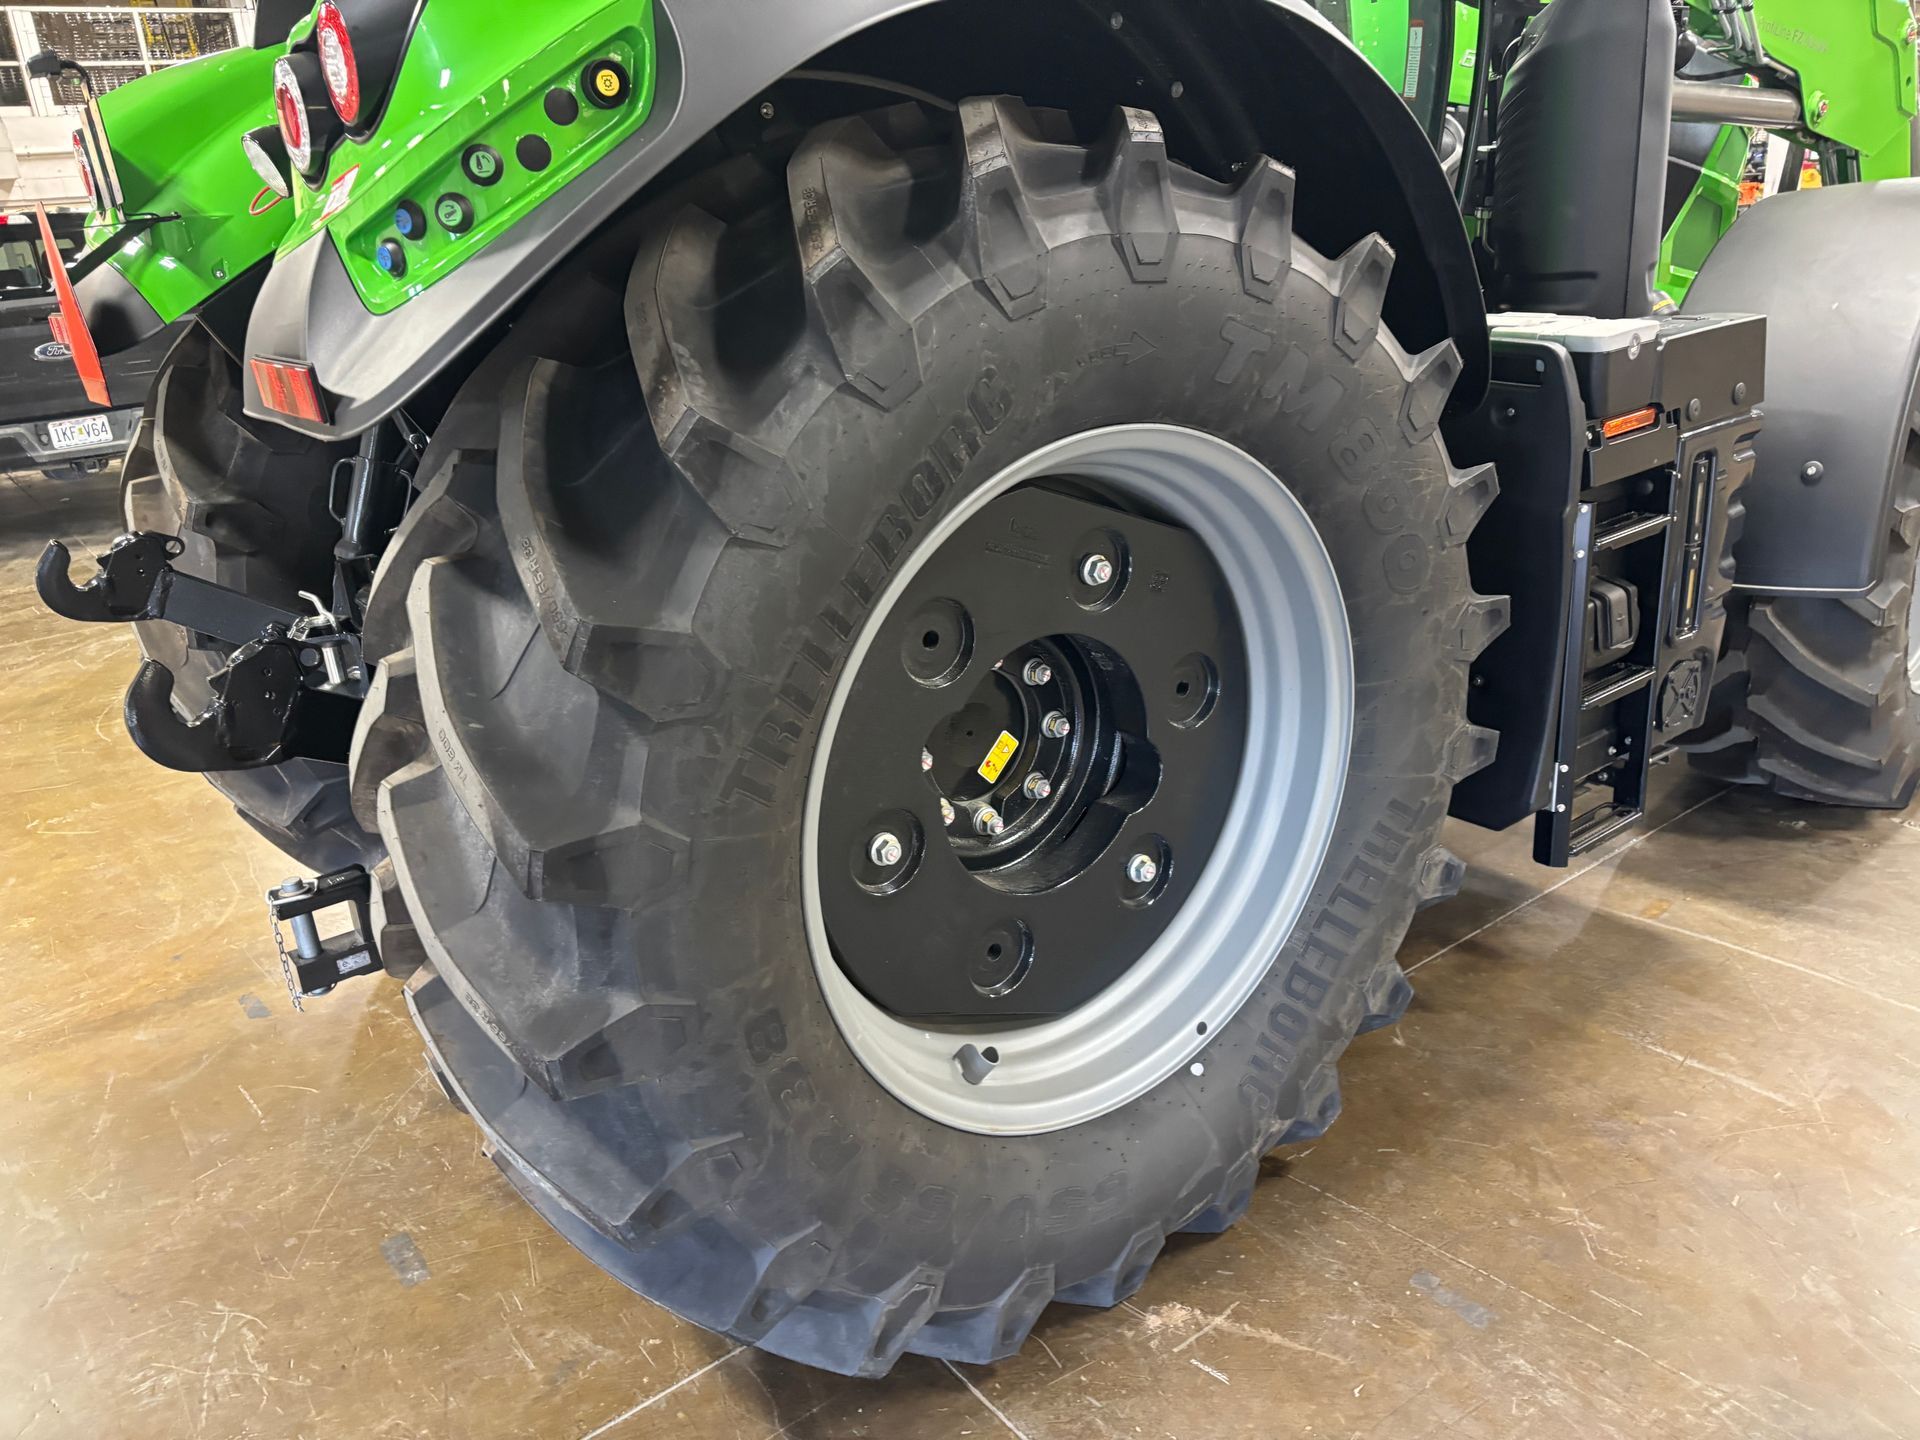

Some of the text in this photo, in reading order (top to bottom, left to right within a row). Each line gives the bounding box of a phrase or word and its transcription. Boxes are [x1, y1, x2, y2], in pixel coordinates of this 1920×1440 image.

[82, 420, 108, 438] V64
[717, 366, 1010, 804] TRELLEBORG
[1236, 800, 1426, 1117] TRELLEBORG
